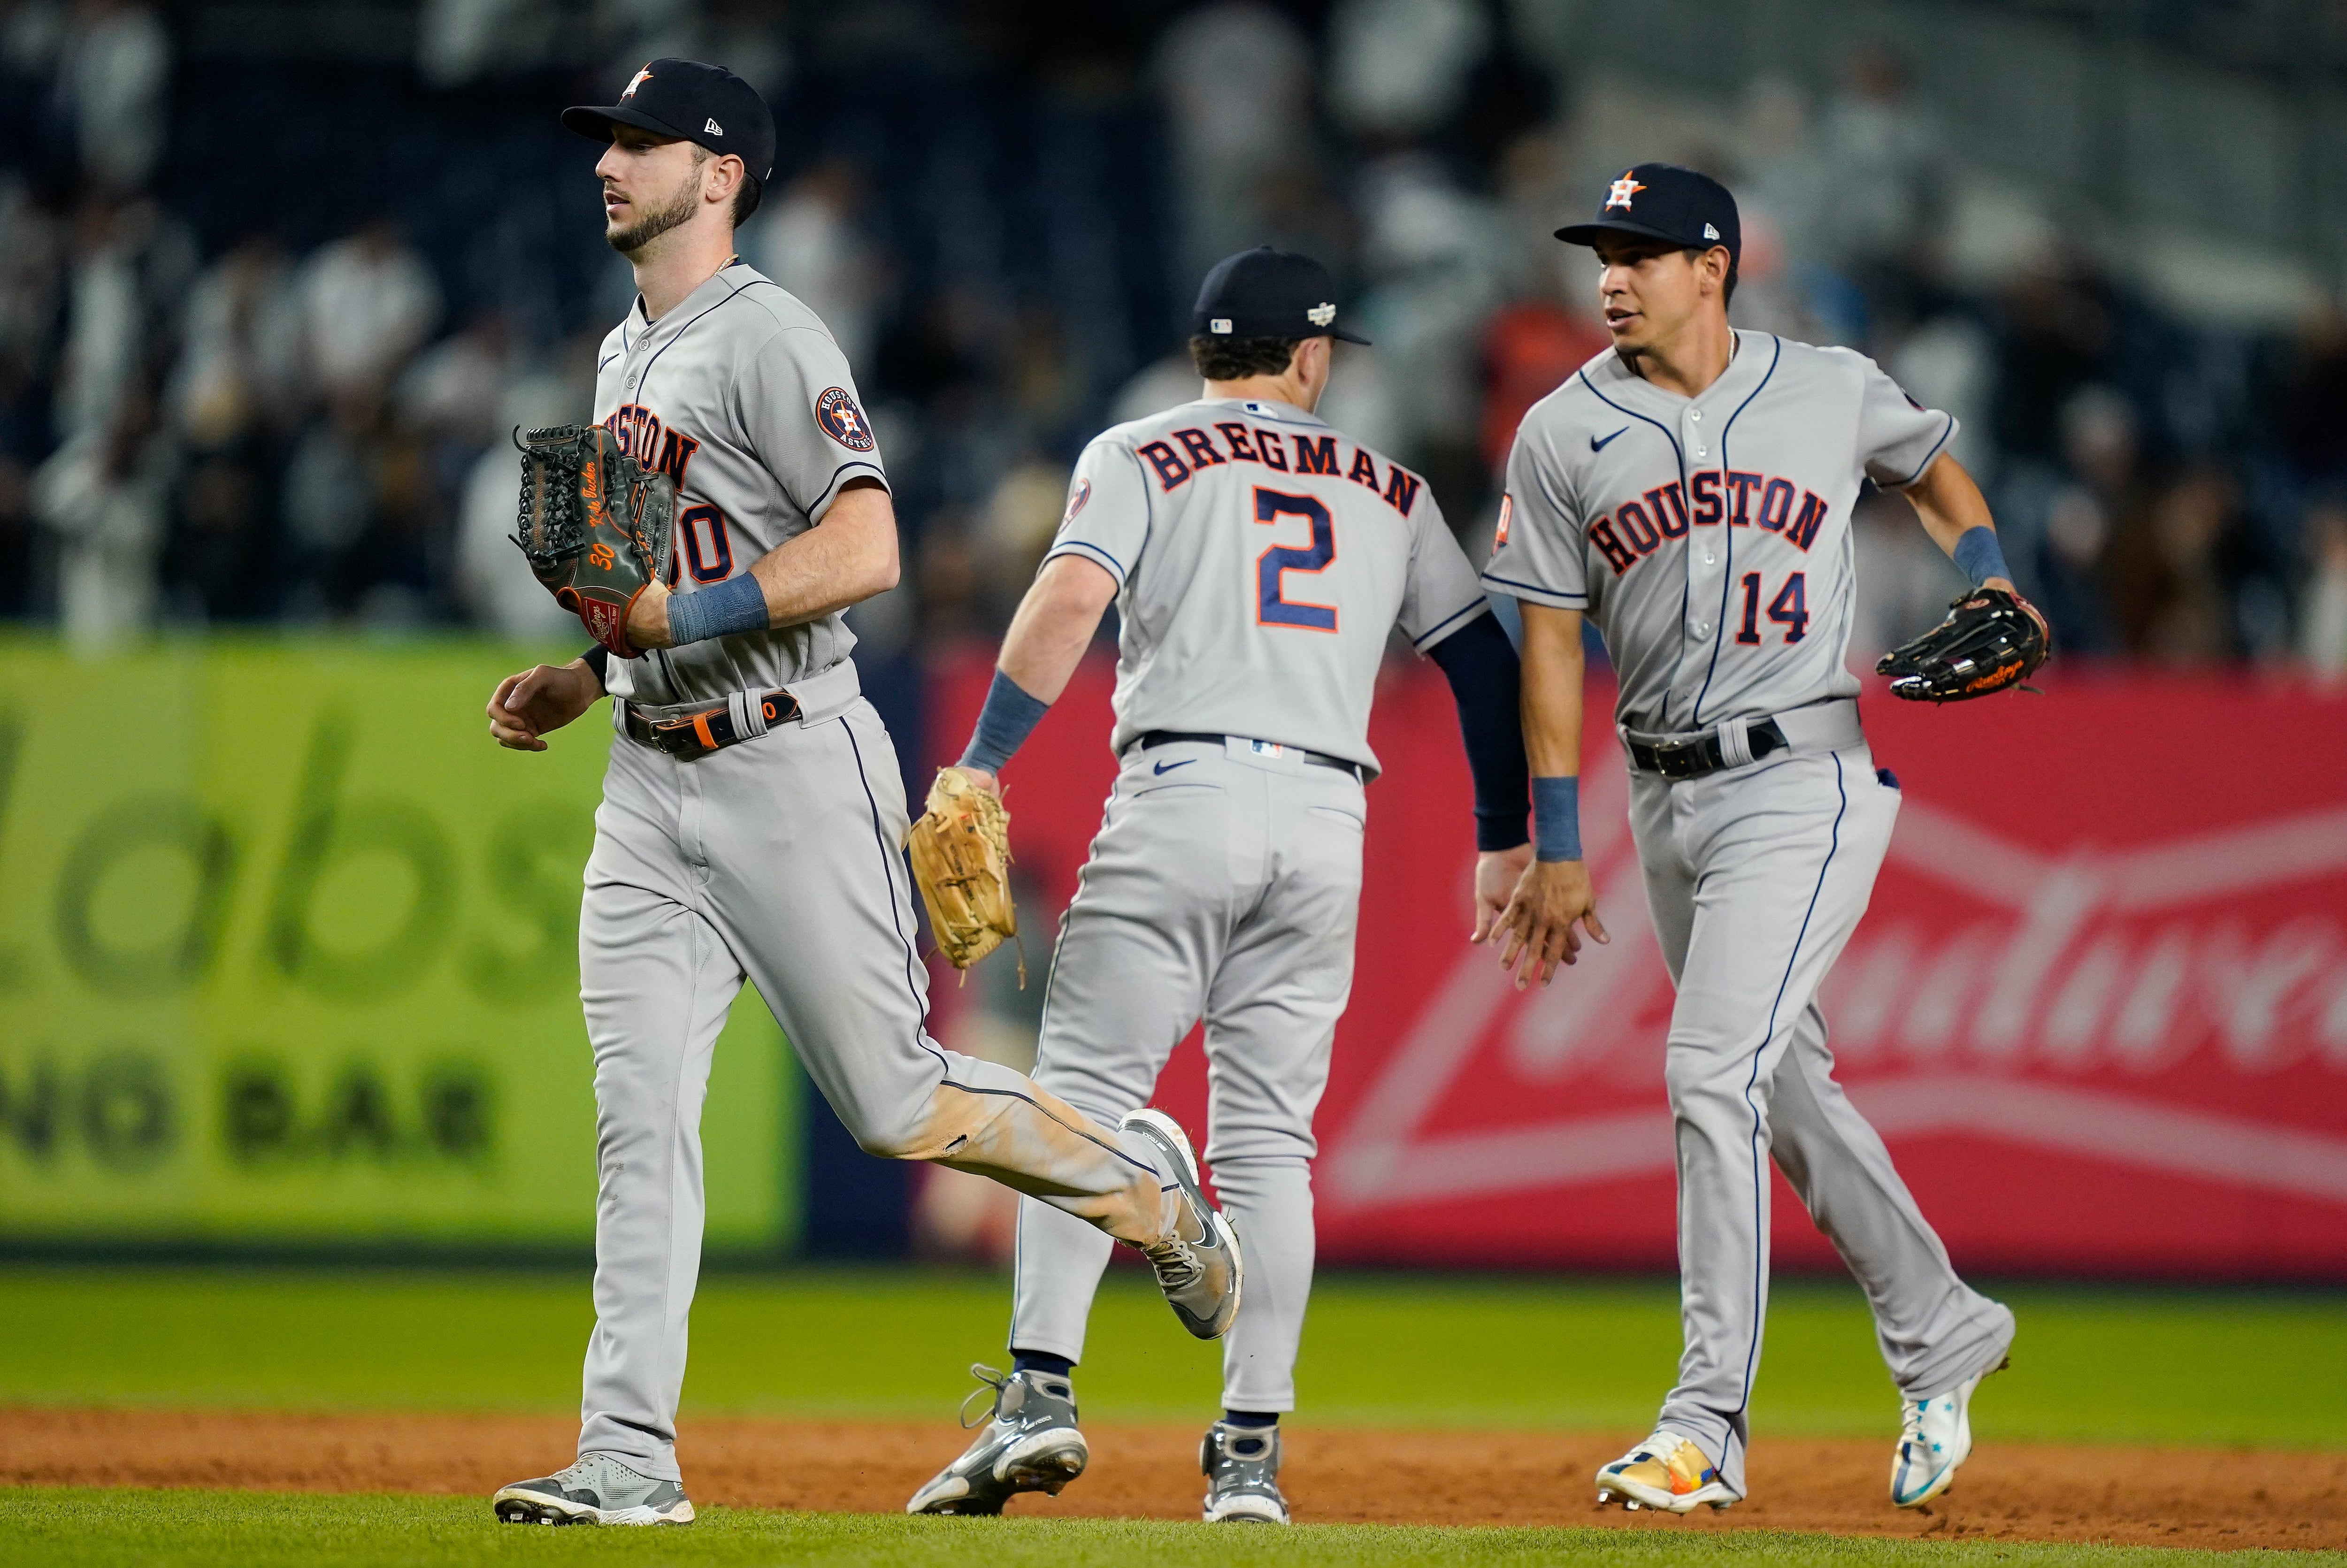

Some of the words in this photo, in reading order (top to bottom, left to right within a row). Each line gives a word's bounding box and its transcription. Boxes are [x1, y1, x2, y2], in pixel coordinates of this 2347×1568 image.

[1605, 180, 1639, 206] H
[821, 390, 856, 411] HOUSTON
[836, 409, 861, 431] H
[581, 461, 598, 498] Tucker
[1137, 421, 1422, 519] BREGMAN
[1588, 469, 1829, 577] HOUSTON
[589, 543, 615, 571] 30
[1252, 484, 1339, 634] 2
[591, 605, 610, 644] Rawlings
[1735, 570, 1810, 646] 14
